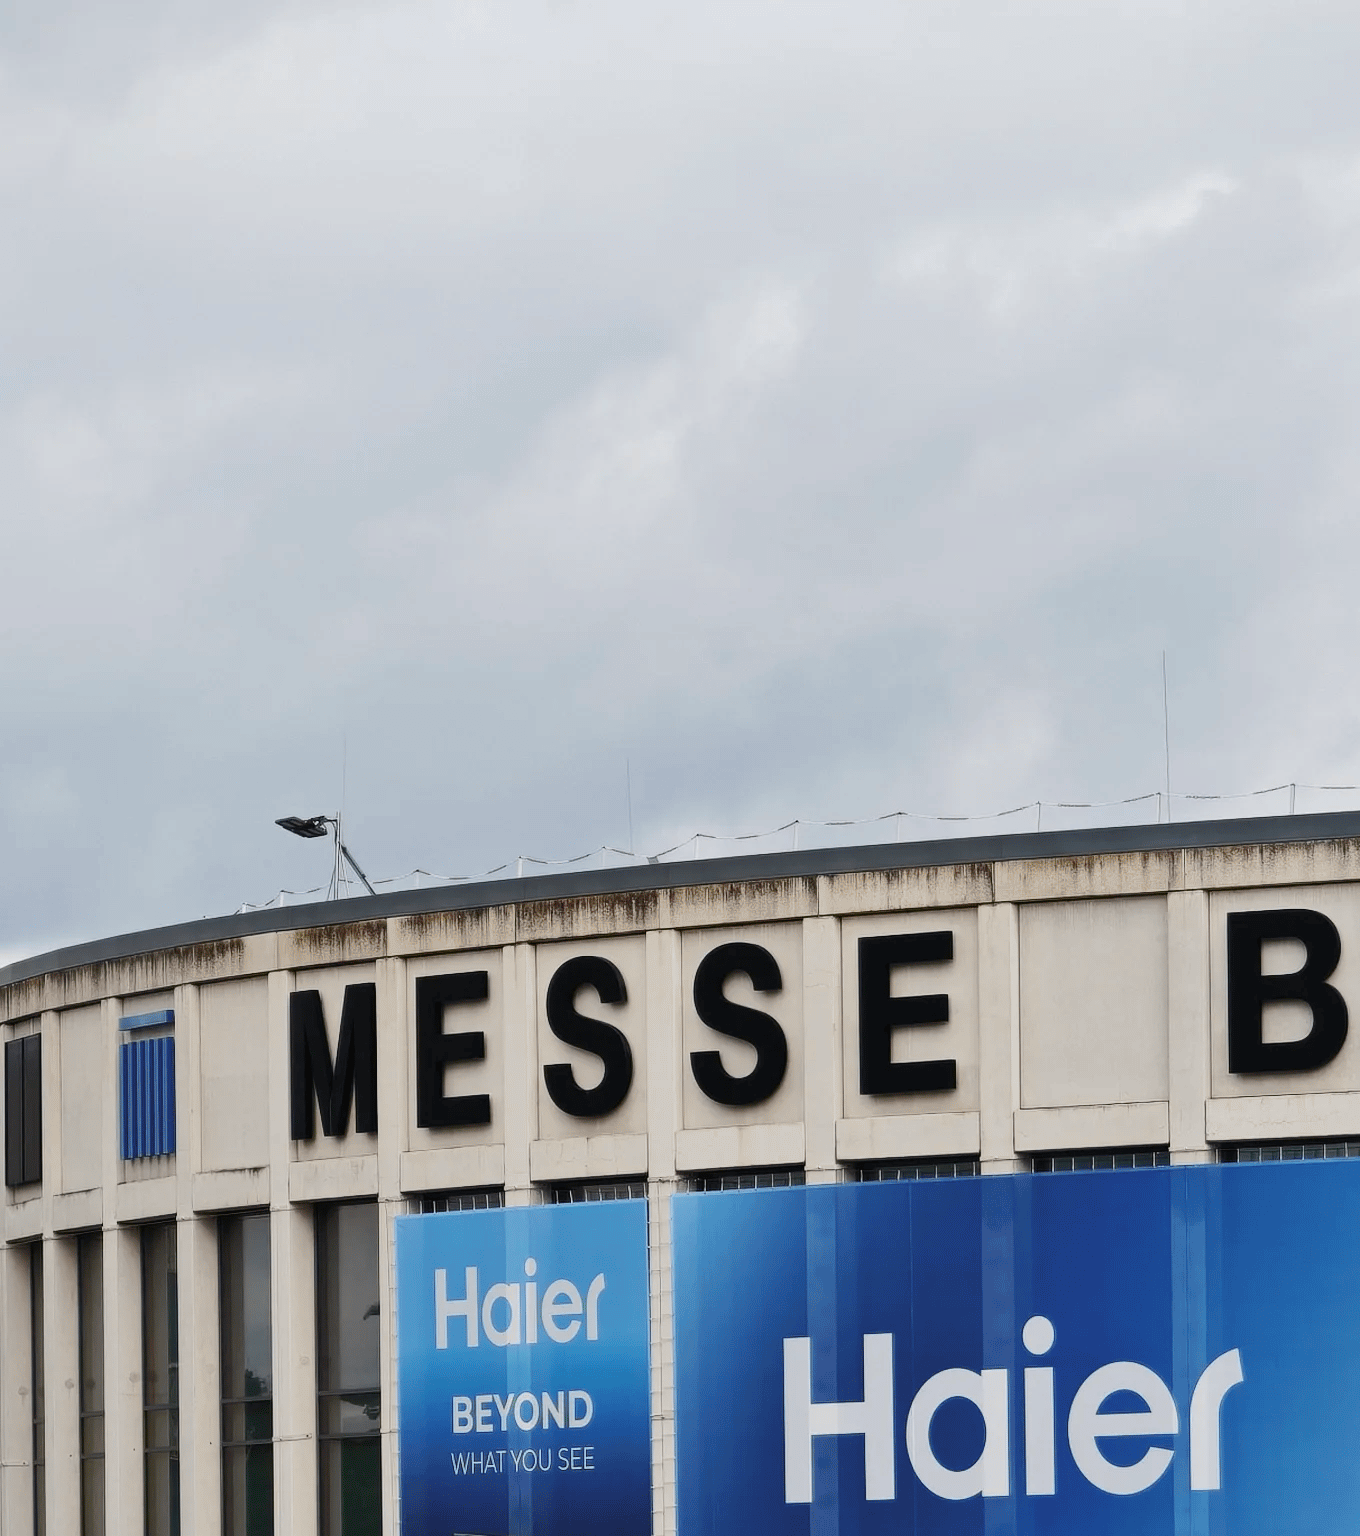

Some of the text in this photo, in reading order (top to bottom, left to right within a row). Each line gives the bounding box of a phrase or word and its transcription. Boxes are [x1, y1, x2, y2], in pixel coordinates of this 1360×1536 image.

[290, 931, 957, 1139] MESSE
[434, 1258, 606, 1349] Haier
[452, 1390, 594, 1434] BEYOND
[783, 1315, 1244, 1504] Haier
[451, 1446, 595, 1475] WHAT YOU SEE
